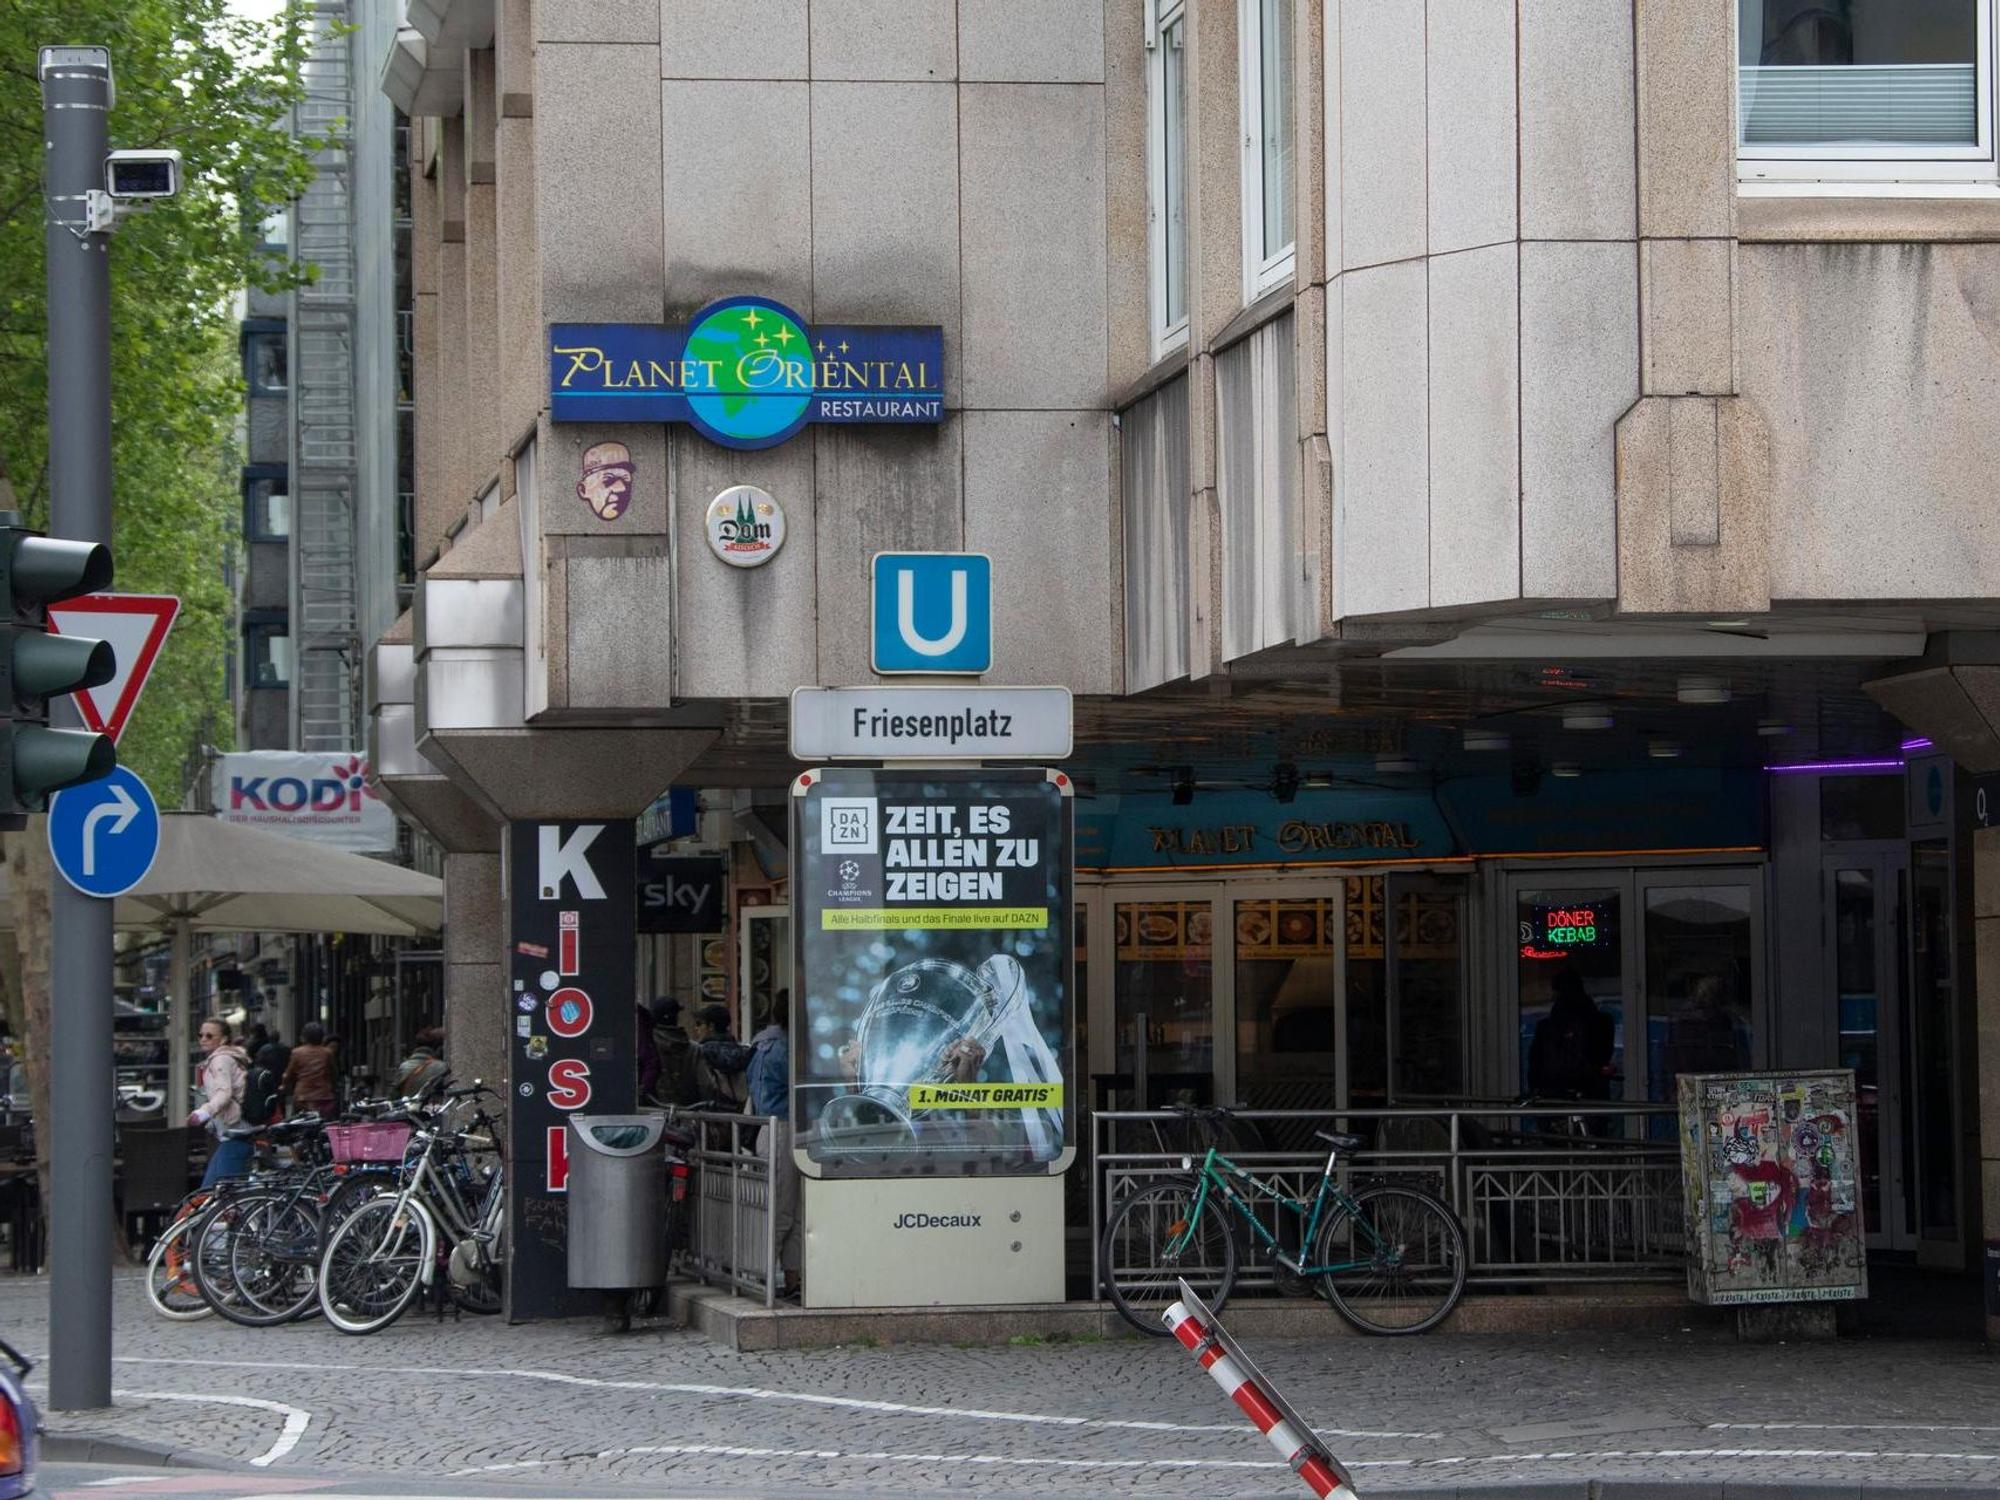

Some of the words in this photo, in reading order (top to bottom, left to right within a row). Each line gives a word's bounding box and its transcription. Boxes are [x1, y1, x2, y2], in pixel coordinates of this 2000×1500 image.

[553, 345, 722, 388] PLANET
[736, 349, 937, 389] ORIENTAL
[820, 401, 940, 418] RESTAURANT
[718, 520, 772, 543] Dom
[898, 569, 967, 656] U
[853, 708, 1012, 745] Friesenplatz
[885, 806, 962, 837] ZEIT,
[970, 805, 1011, 834] ES
[885, 839, 987, 867] ALLEN
[995, 839, 1039, 867] ZU
[644, 874, 710, 914] sky
[885, 872, 1003, 901] ZEIGEN
[831, 914, 849, 924] Alle
[850, 914, 900, 924] Halbfinals
[902, 914, 921, 924] und
[923, 914, 941, 924] das
[943, 914, 971, 924] Finale
[973, 913, 990, 923] live
[992, 913, 1009, 923] auf
[1011, 913, 1039, 923] DAZN
[1548, 910, 1595, 927] DÖNER
[1548, 927, 1596, 943] KEBAB
[918, 1090, 931, 1103] 1.
[935, 1089, 991, 1103] MONAT
[894, 1213, 982, 1229] JCDecaux
